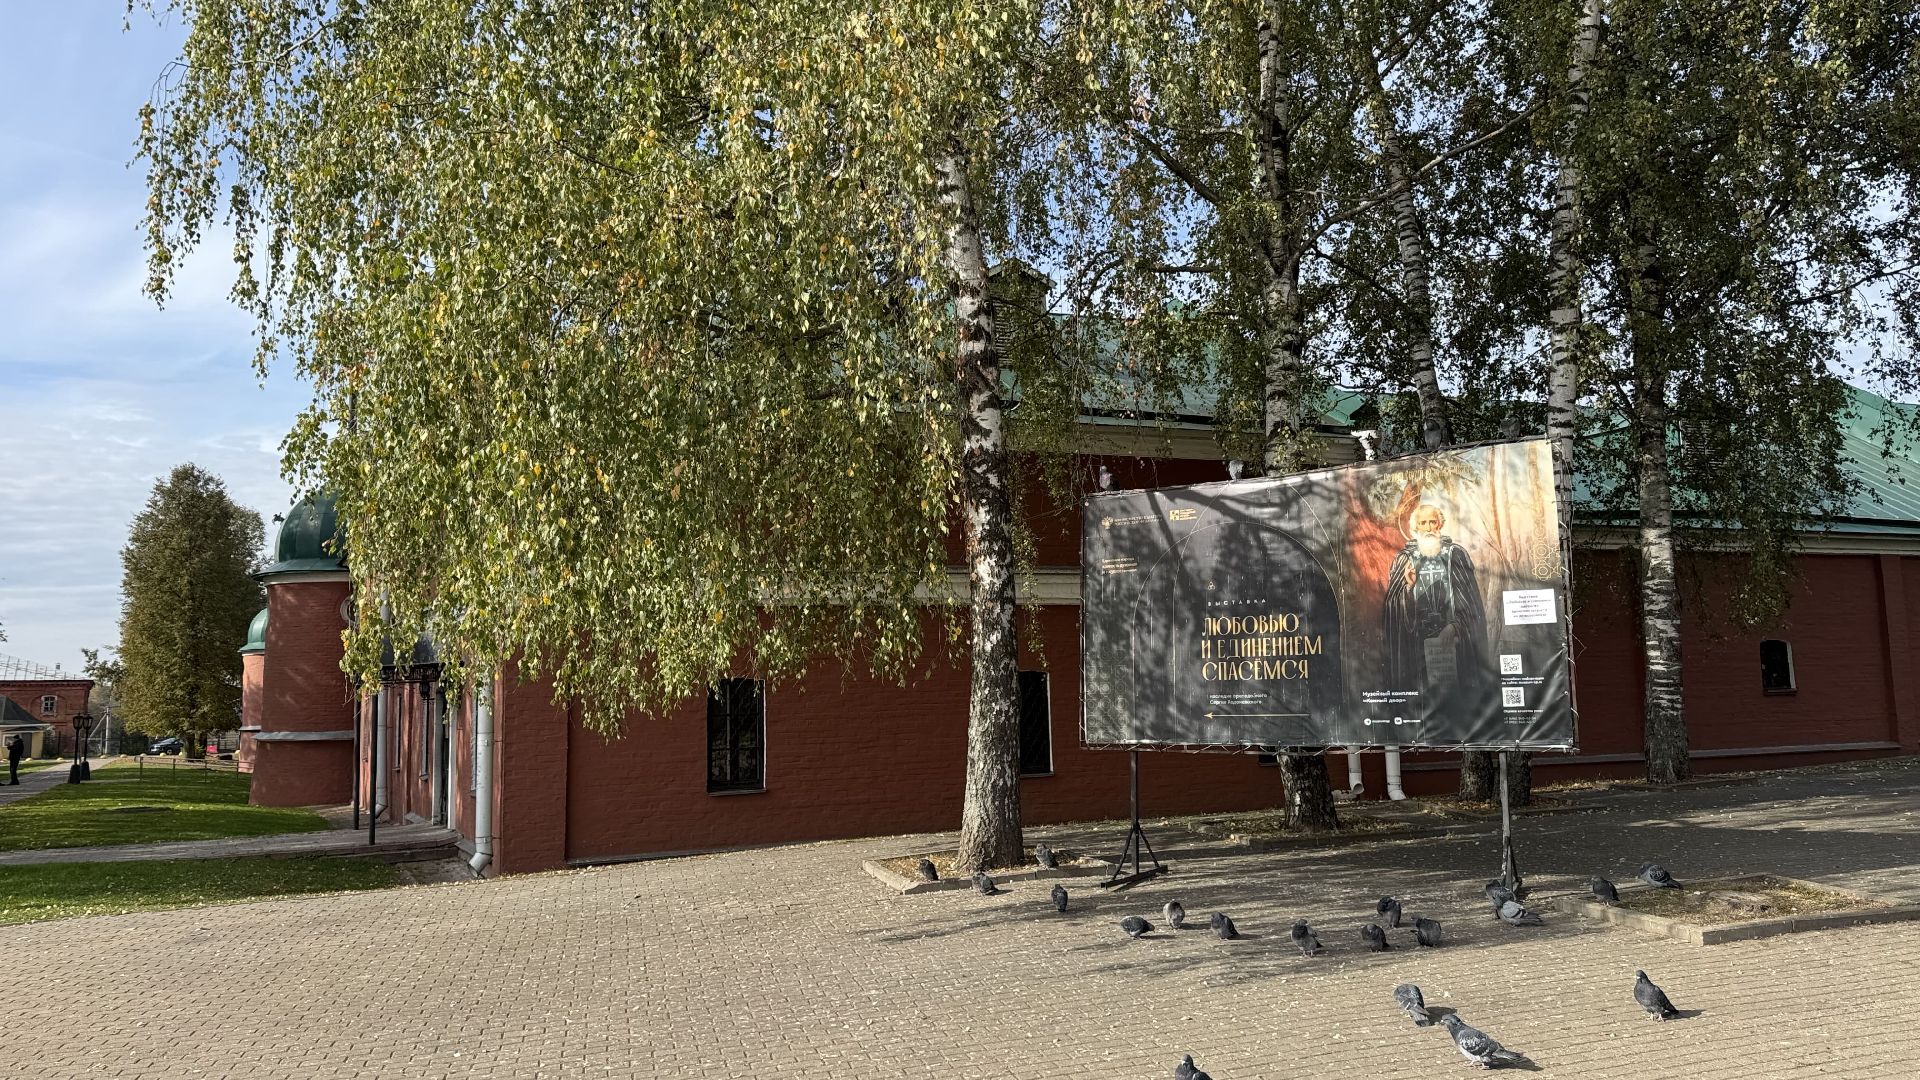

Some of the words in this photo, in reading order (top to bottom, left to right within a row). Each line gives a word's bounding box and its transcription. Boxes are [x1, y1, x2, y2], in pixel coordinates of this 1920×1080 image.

[1207, 598, 1266, 607] ВЫСТАВКА
[1202, 612, 1300, 637] ЛЮБОВЬЮ
[1201, 639, 1211, 659] И
[1217, 635, 1322, 660] ЕДИНЕНИЕМ
[1202, 658, 1309, 681] СПАСЁМСЯ
